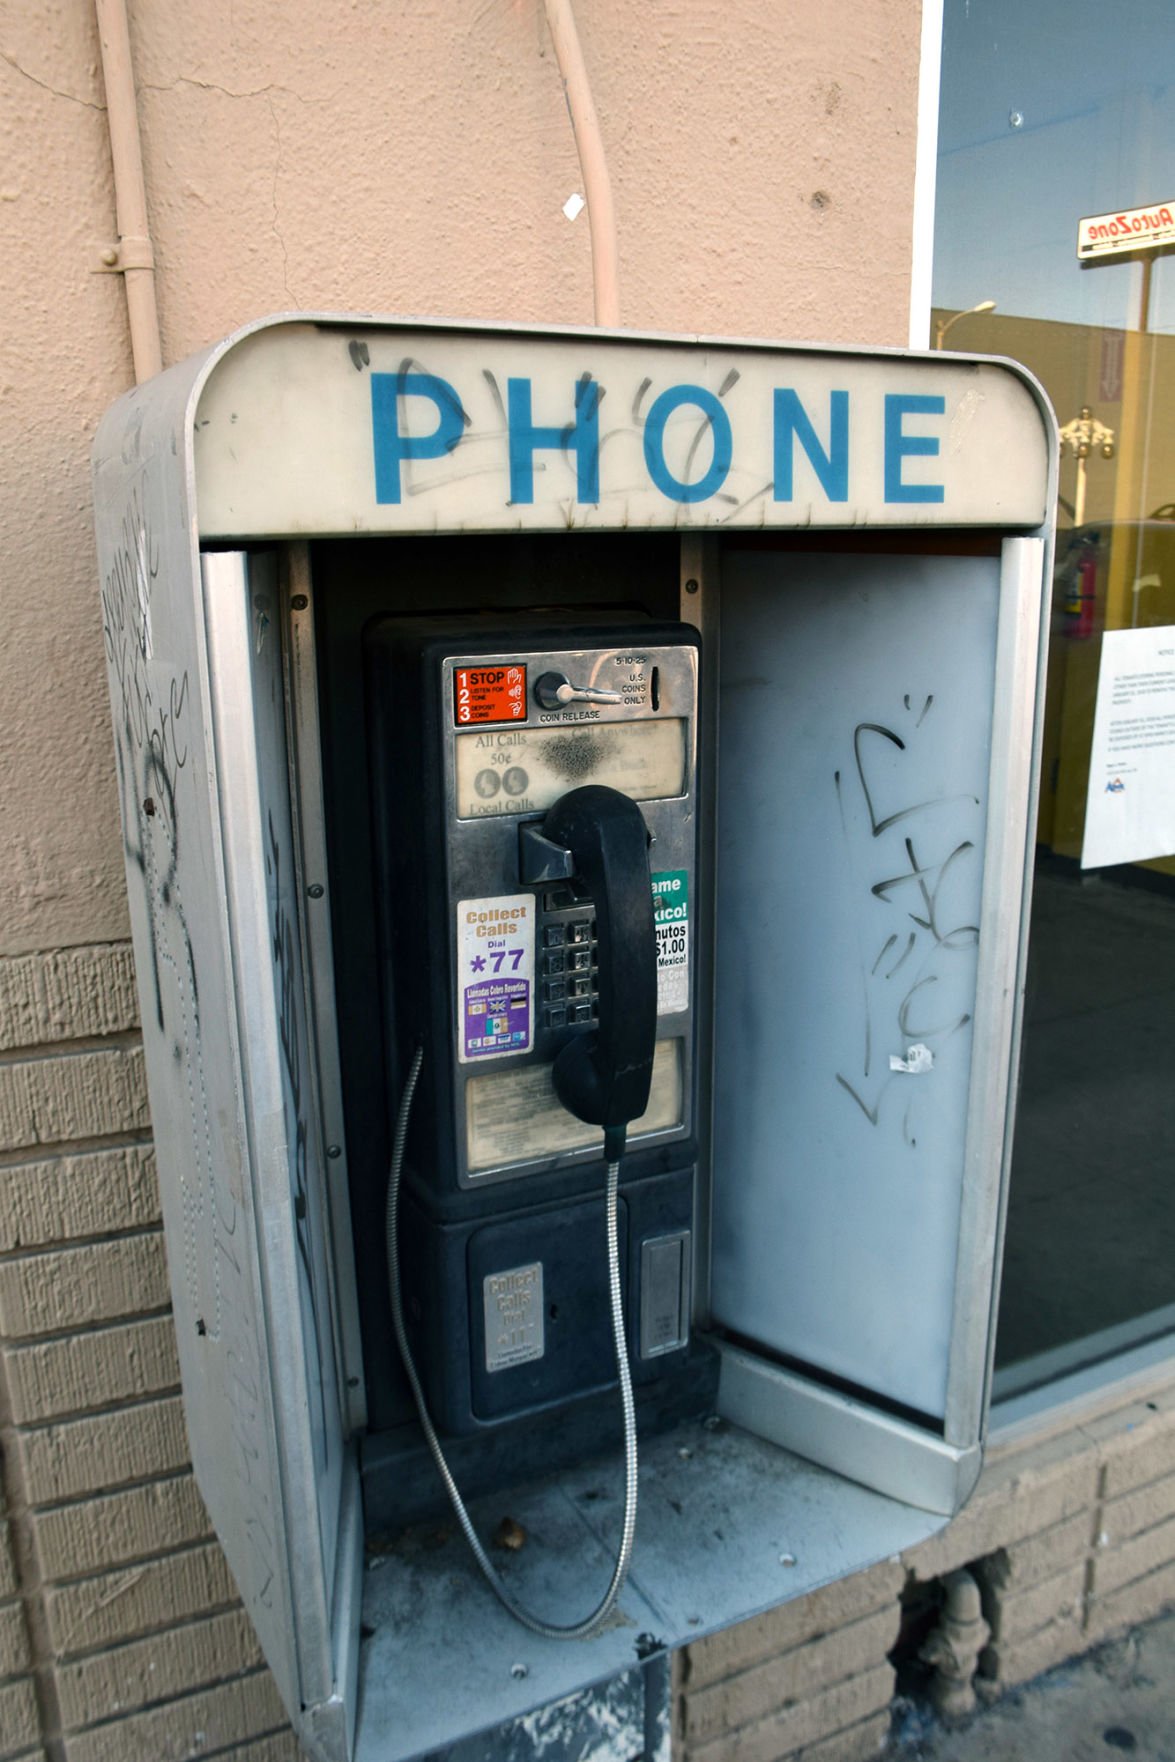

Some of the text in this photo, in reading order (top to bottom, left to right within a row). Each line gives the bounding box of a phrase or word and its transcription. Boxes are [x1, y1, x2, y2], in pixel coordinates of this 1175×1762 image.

[369, 371, 946, 505] PHONE
[459, 671, 505, 688] 1 STOP
[629, 673, 646, 682] U.S.
[459, 688, 470, 704] 2
[621, 684, 647, 693] COINS
[624, 695, 646, 705] ONLY
[459, 705, 471, 721] 3
[540, 710, 600, 723] COIN RELEASE
[475, 732, 527, 748] All Calls
[491, 752, 512, 765] 50¢
[470, 798, 535, 815] Local Calls
[652, 878, 681, 894] ame
[466, 906, 527, 924] Collect
[476, 922, 518, 938] Calls
[656, 925, 687, 939] nutos
[487, 939, 506, 948] Dial
[658, 954, 687, 968] Mexico!
[489, 1270, 537, 1295] Collect
[497, 1290, 531, 1311] Calls
